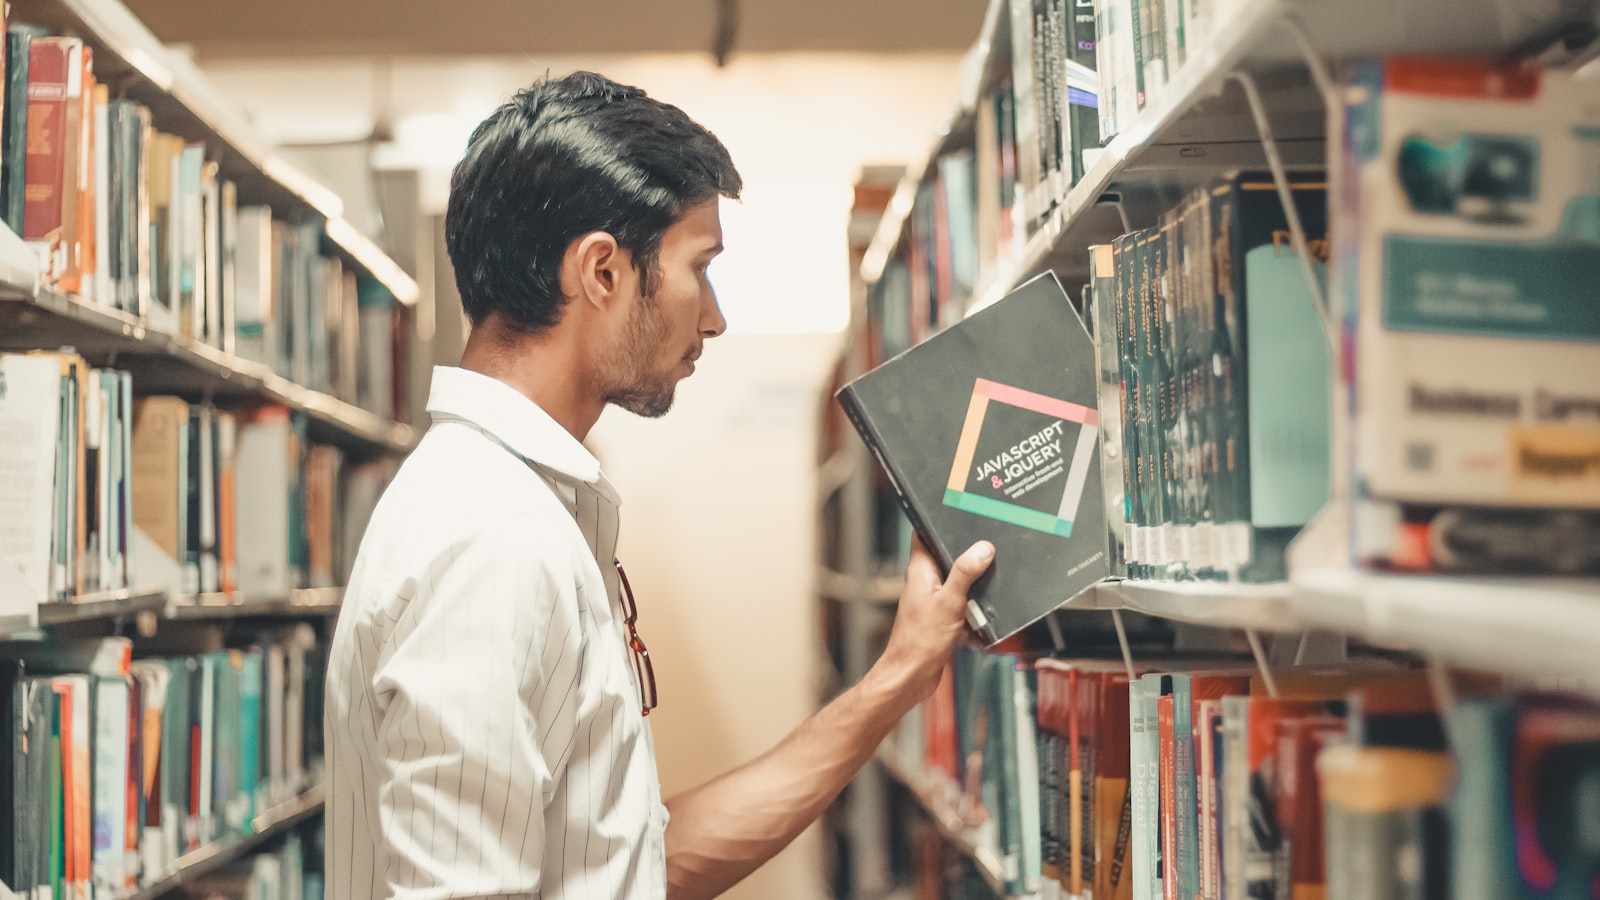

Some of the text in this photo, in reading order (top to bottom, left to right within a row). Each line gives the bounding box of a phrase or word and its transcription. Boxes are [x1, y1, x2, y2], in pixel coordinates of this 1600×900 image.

[976, 420, 1063, 481] JAVASCRIPT
[991, 439, 1061, 489] & JQUERY
[1025, 466, 1064, 492] development
[1135, 761, 1146, 828] Digital
